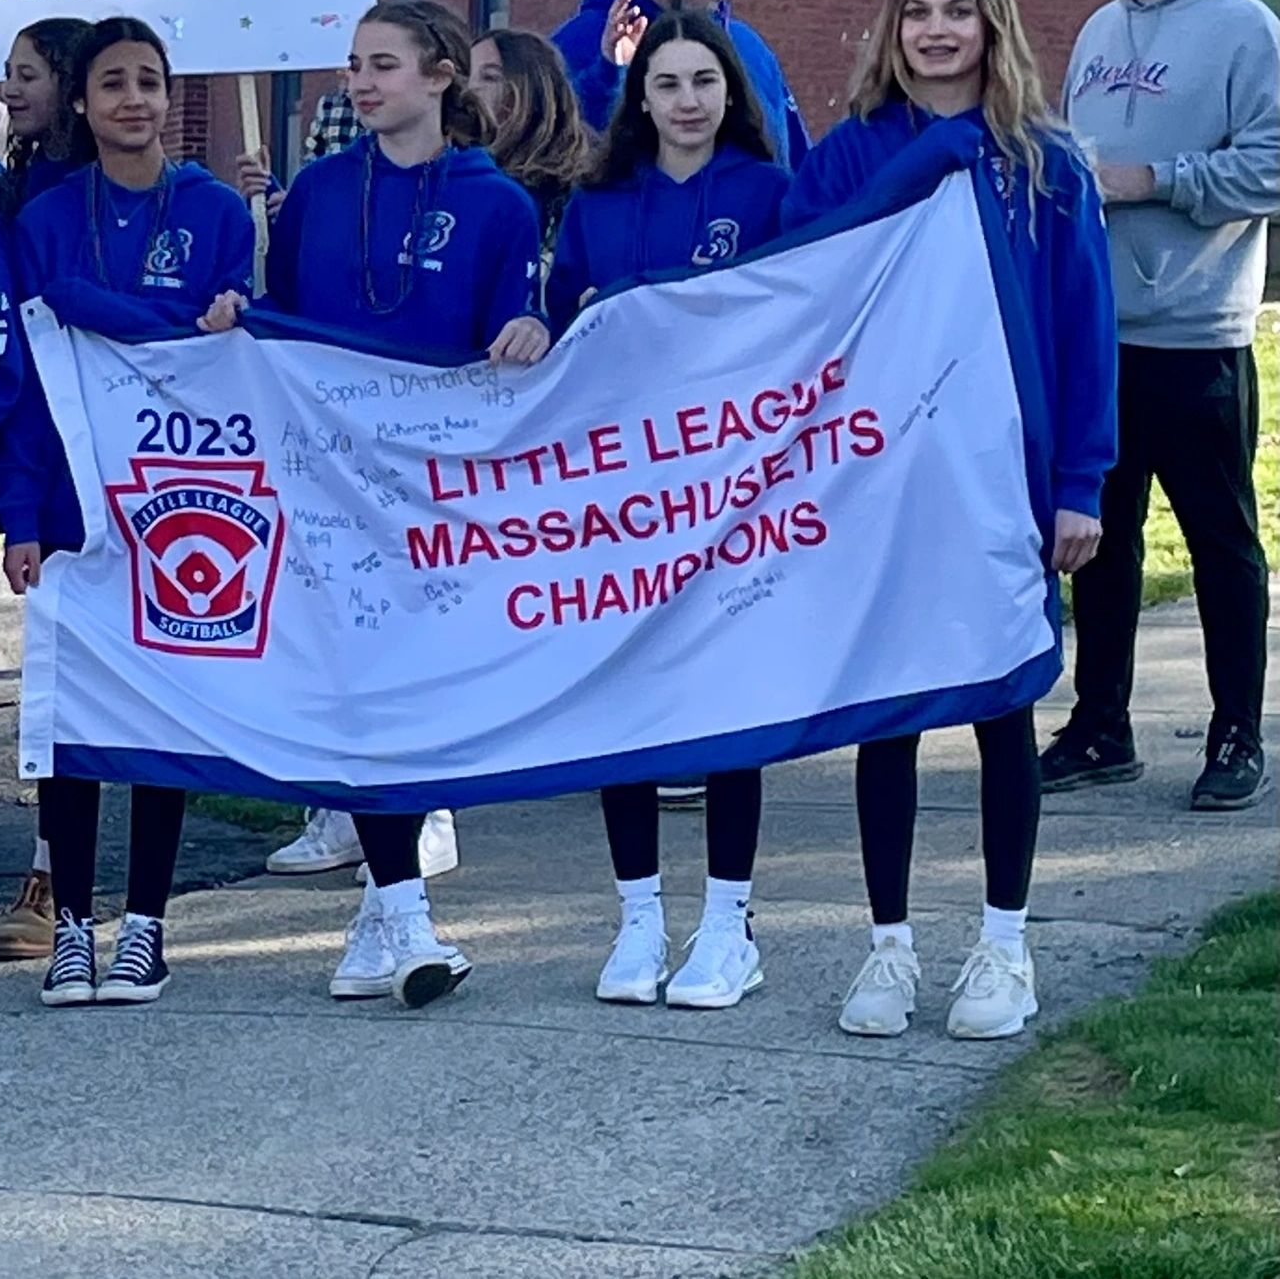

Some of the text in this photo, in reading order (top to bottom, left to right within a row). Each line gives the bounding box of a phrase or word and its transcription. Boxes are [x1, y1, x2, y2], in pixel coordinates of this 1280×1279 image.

[315, 379, 381, 406] Sophia
[136, 408, 256, 457] 2023
[426, 425, 626, 503] LITTLE
[642, 358, 845, 464] LEAGUE
[135, 491, 267, 533] LITTLE LEAGUE
[406, 409, 885, 570] MASSACHUSETTS
[506, 501, 827, 630] CHAMPIONS
[158, 615, 243, 640] SOFTBALL
